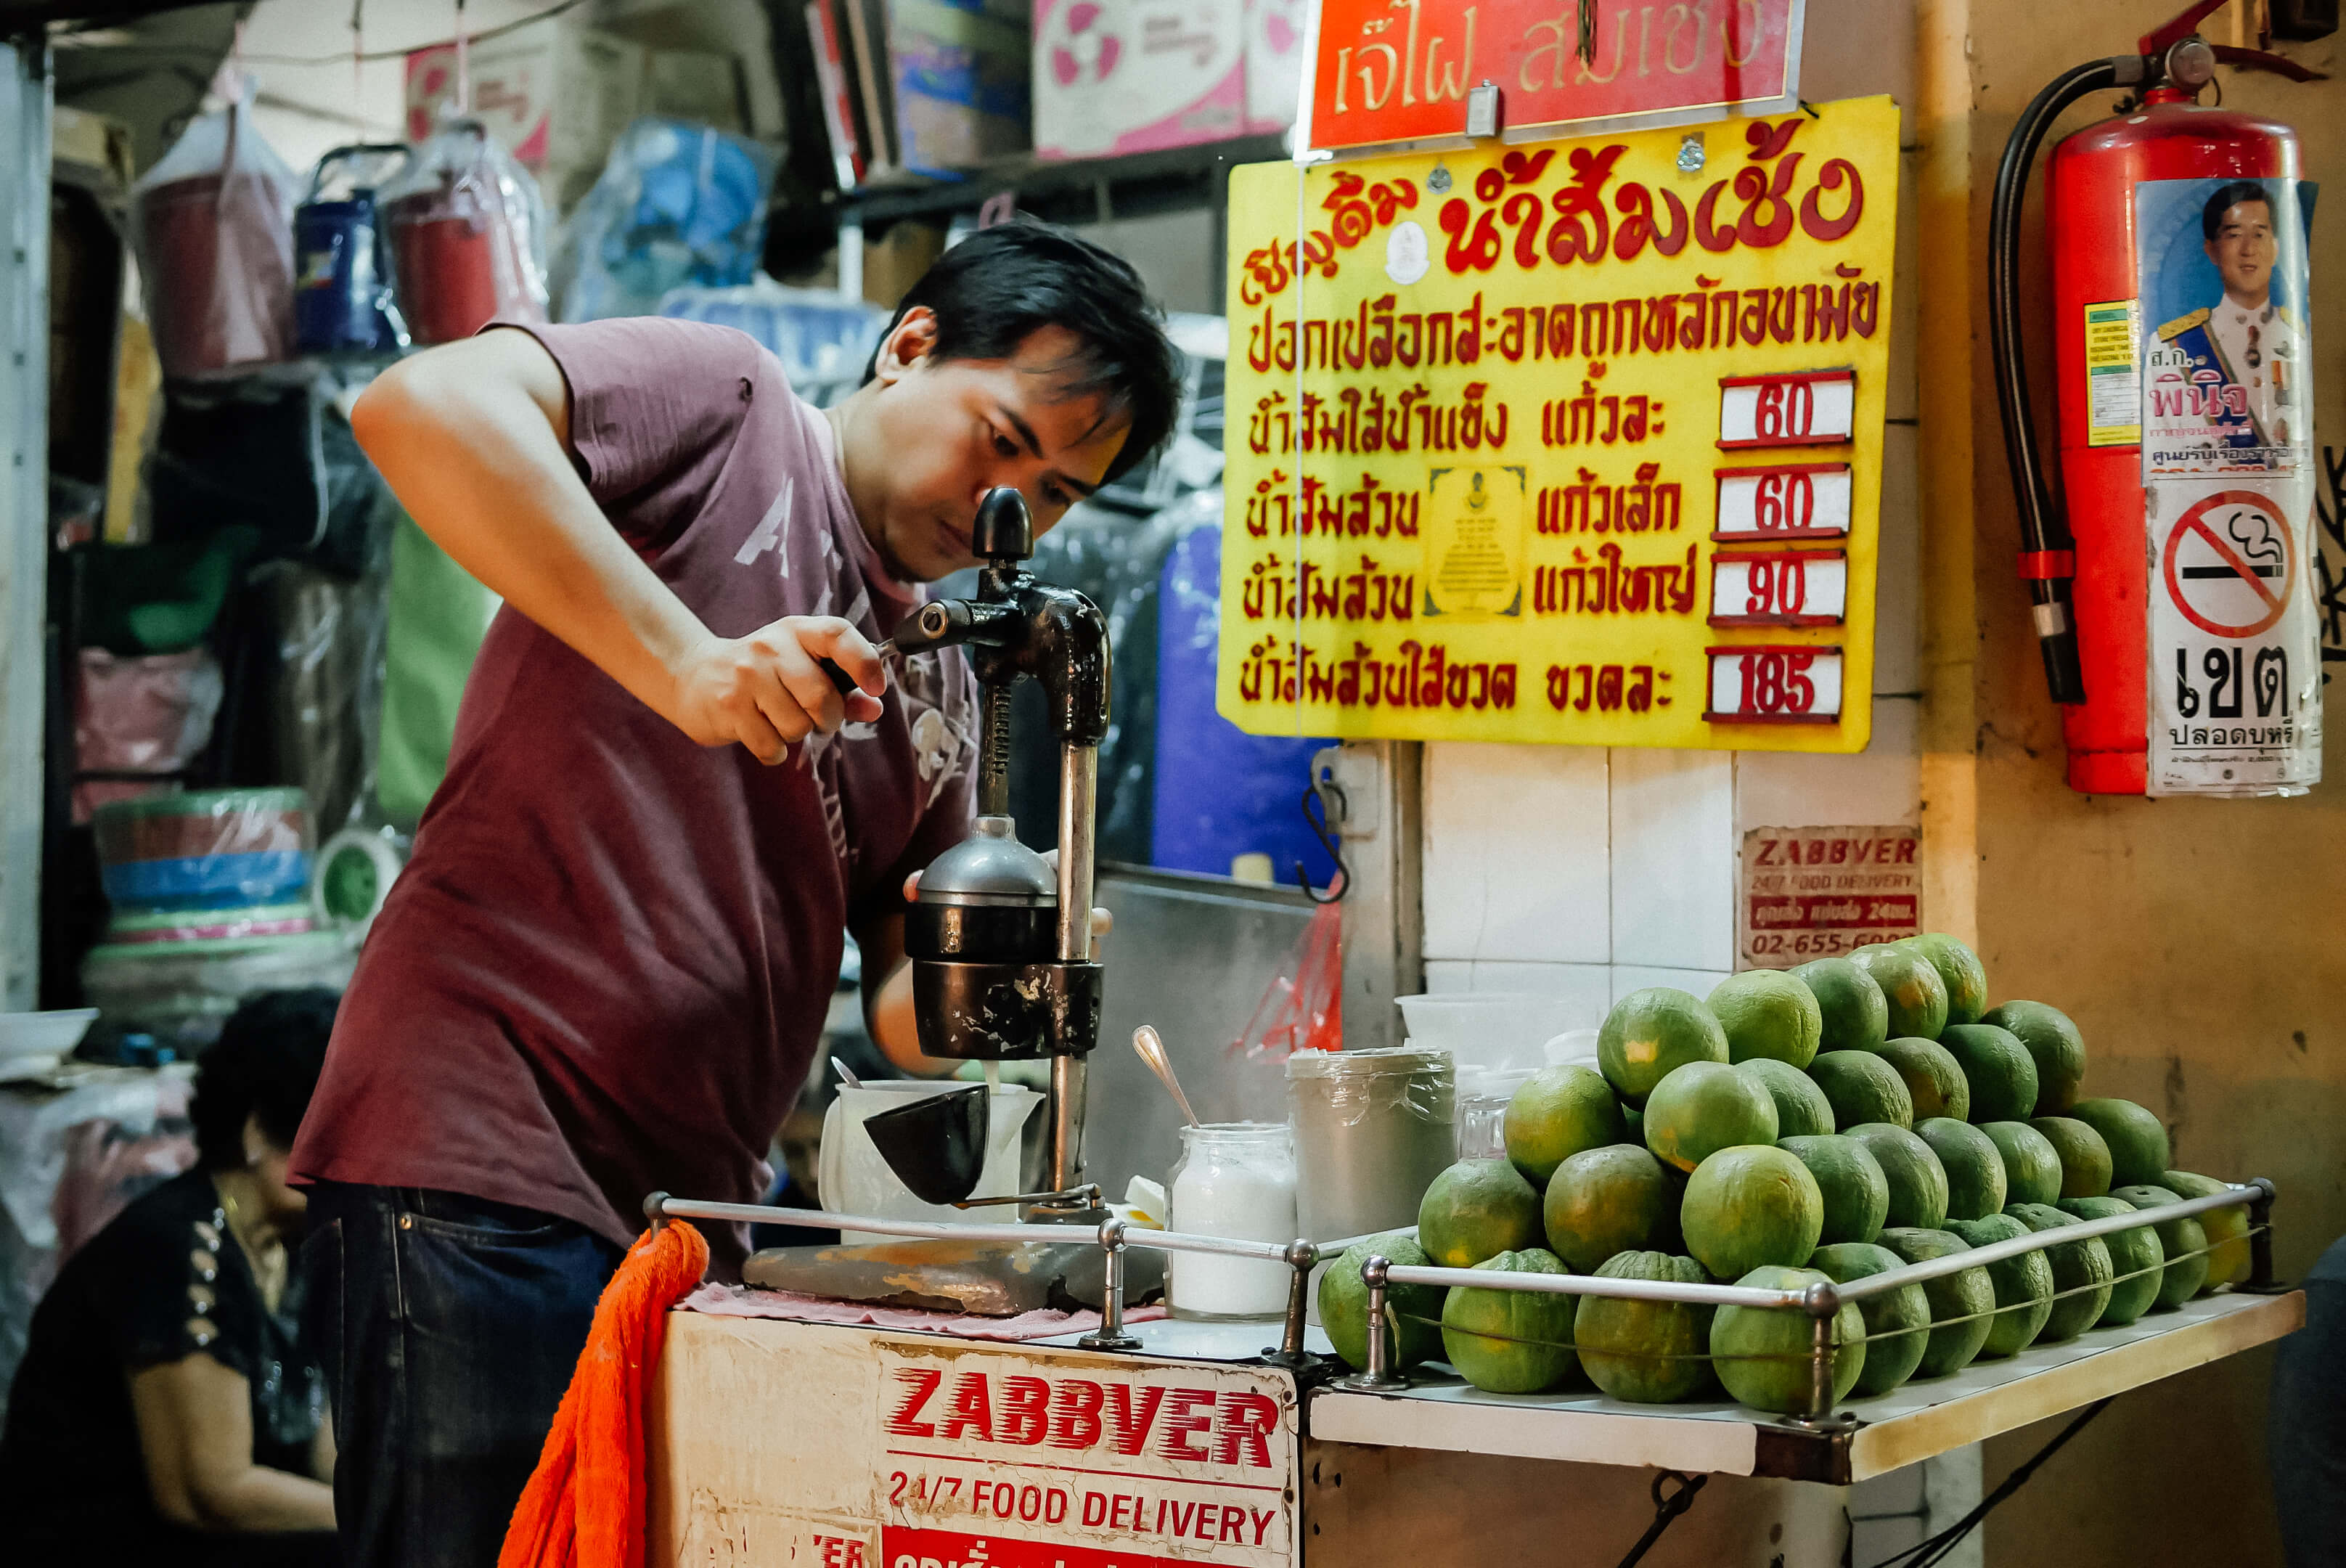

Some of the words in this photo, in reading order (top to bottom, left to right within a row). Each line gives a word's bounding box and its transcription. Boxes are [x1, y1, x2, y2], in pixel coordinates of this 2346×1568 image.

[1439, 118, 1864, 274] น้ำส้มเช้ง
[1541, 379, 1665, 447] แก้วละ
[1755, 382, 1813, 438] 60
[2149, 371, 2248, 417] พินิจ
[1246, 468, 1420, 539] น้ำส้มล้วน
[1537, 462, 1681, 534] แก้วเล็ก
[1755, 473, 1814, 530] 60
[1243, 552, 1415, 621] น้ำส้มล้วน
[1746, 560, 1805, 615] 90
[1546, 664, 1673, 712] ขวดละ
[1738, 655, 1815, 714] 185
[2176, 646, 2289, 719] เขต
[1754, 838, 1916, 866] ZABBVER
[884, 1368, 1279, 1468] ZABBVER
[973, 1480, 1068, 1524] FOOD
[1082, 1490, 1276, 1546] DELIVERY
